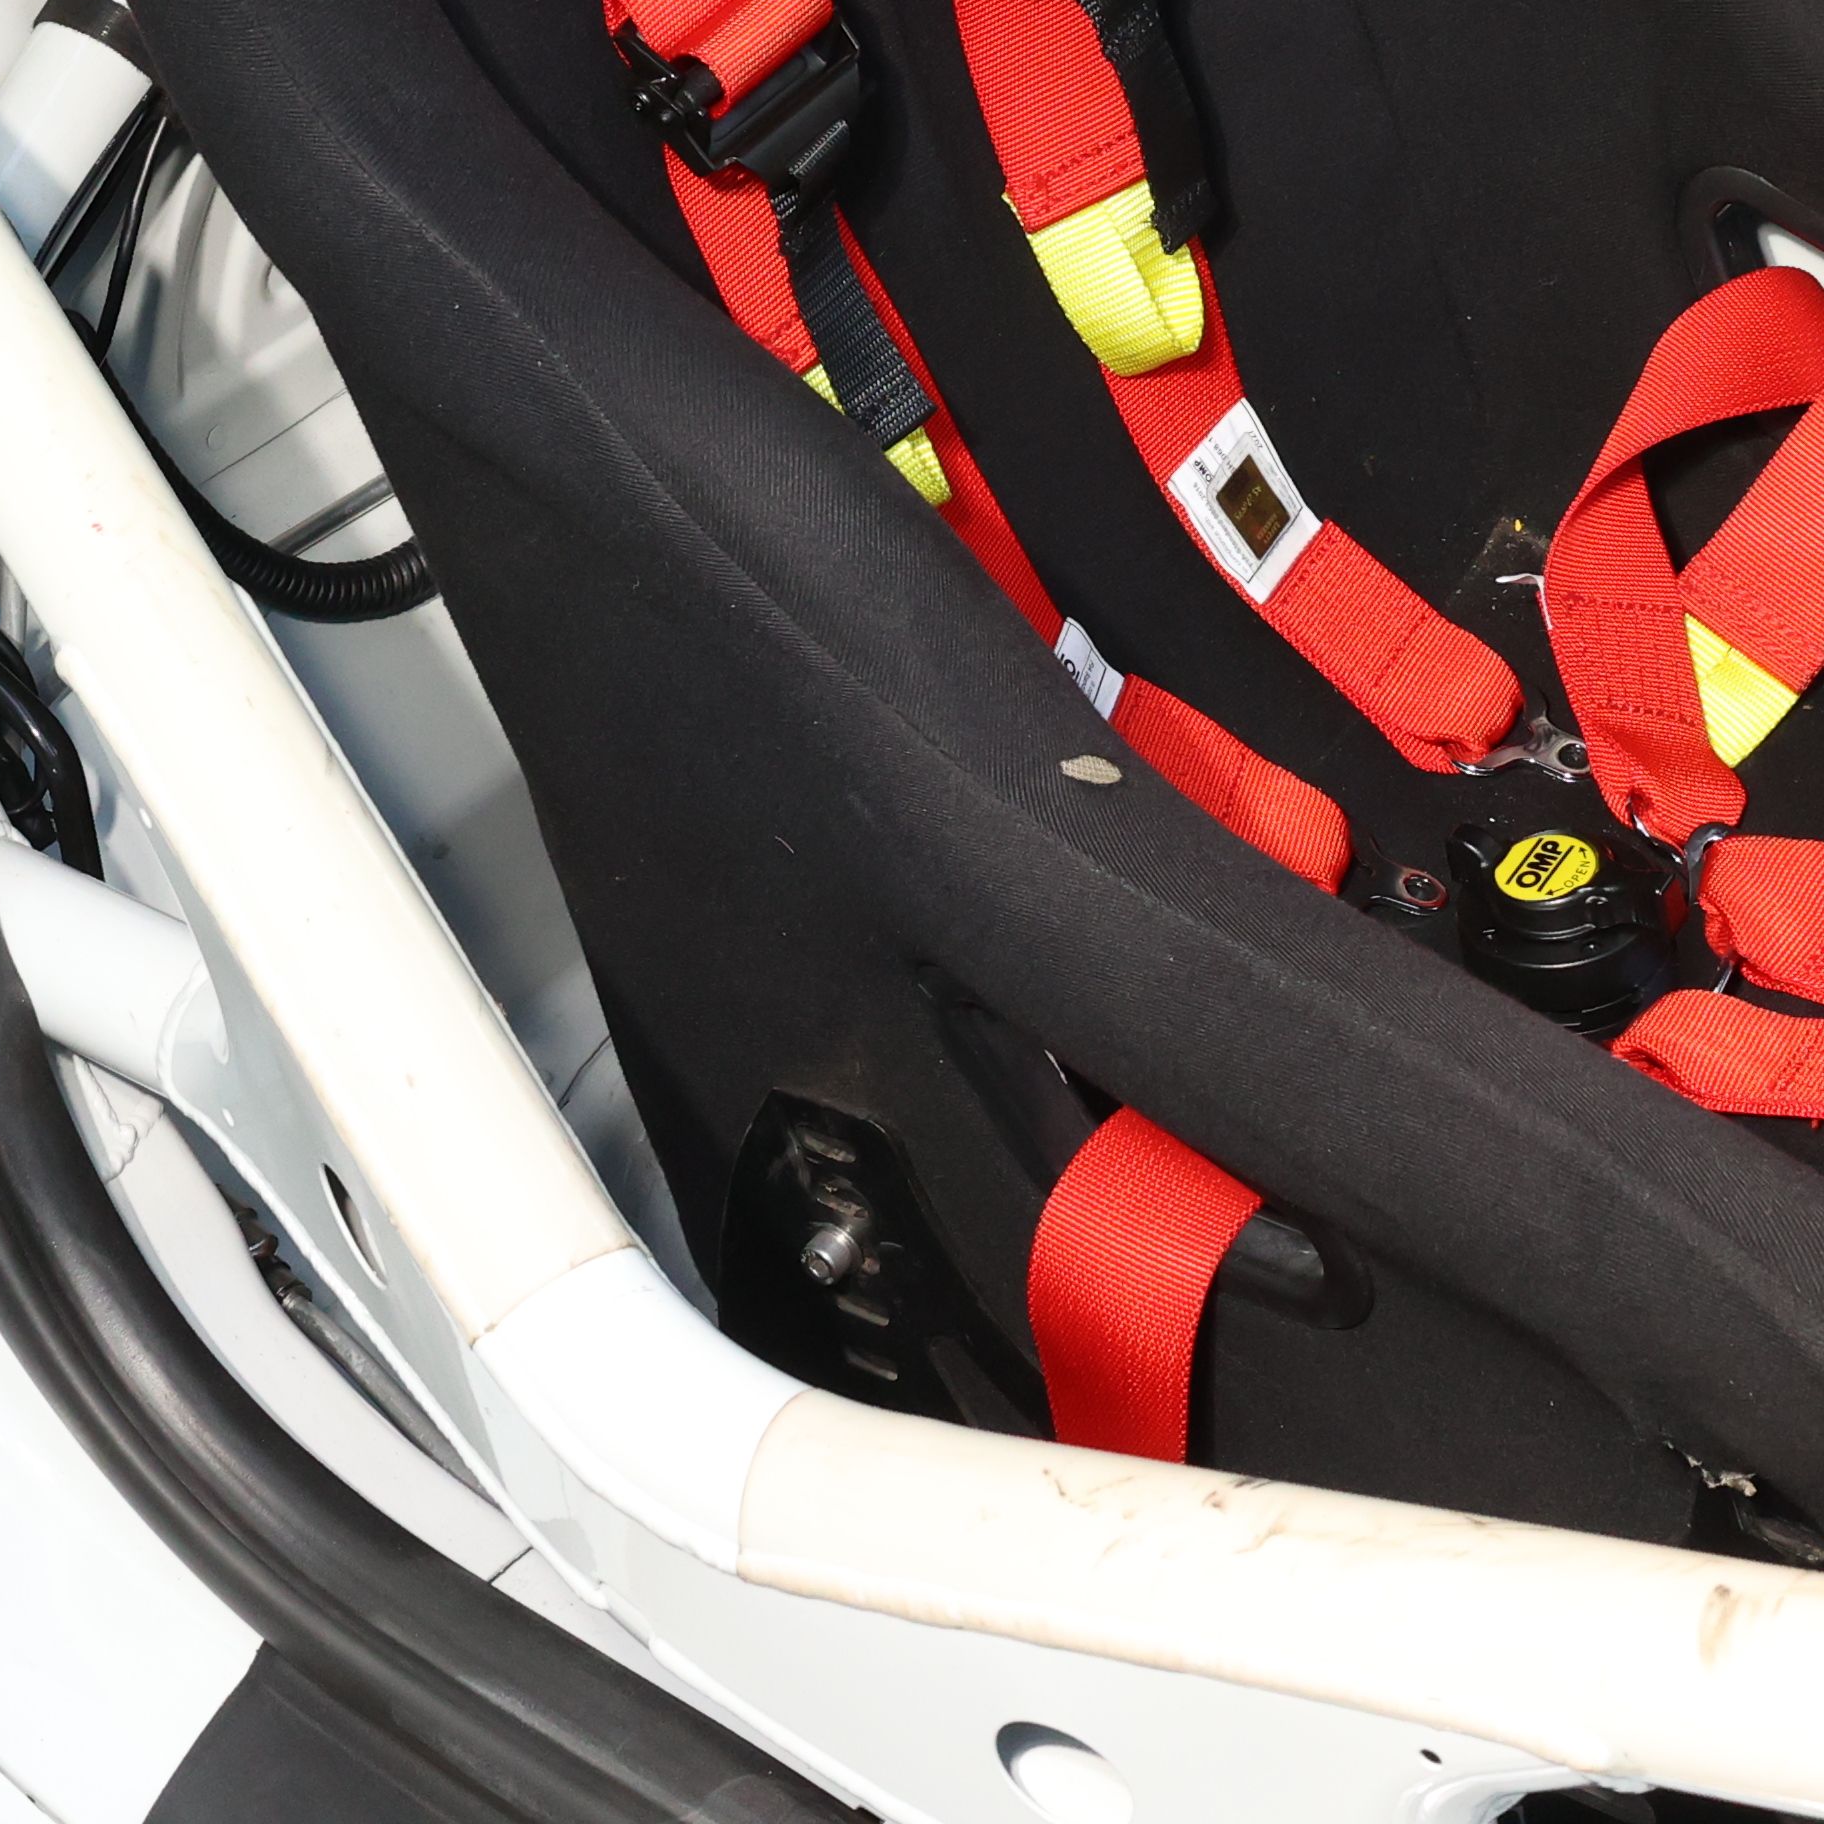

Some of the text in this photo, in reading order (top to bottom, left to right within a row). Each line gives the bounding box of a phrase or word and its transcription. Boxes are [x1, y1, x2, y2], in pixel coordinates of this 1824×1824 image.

[1193, 458, 1214, 483] OMP
[1516, 840, 1564, 888] OMP
[1563, 860, 1591, 888] OPEN
